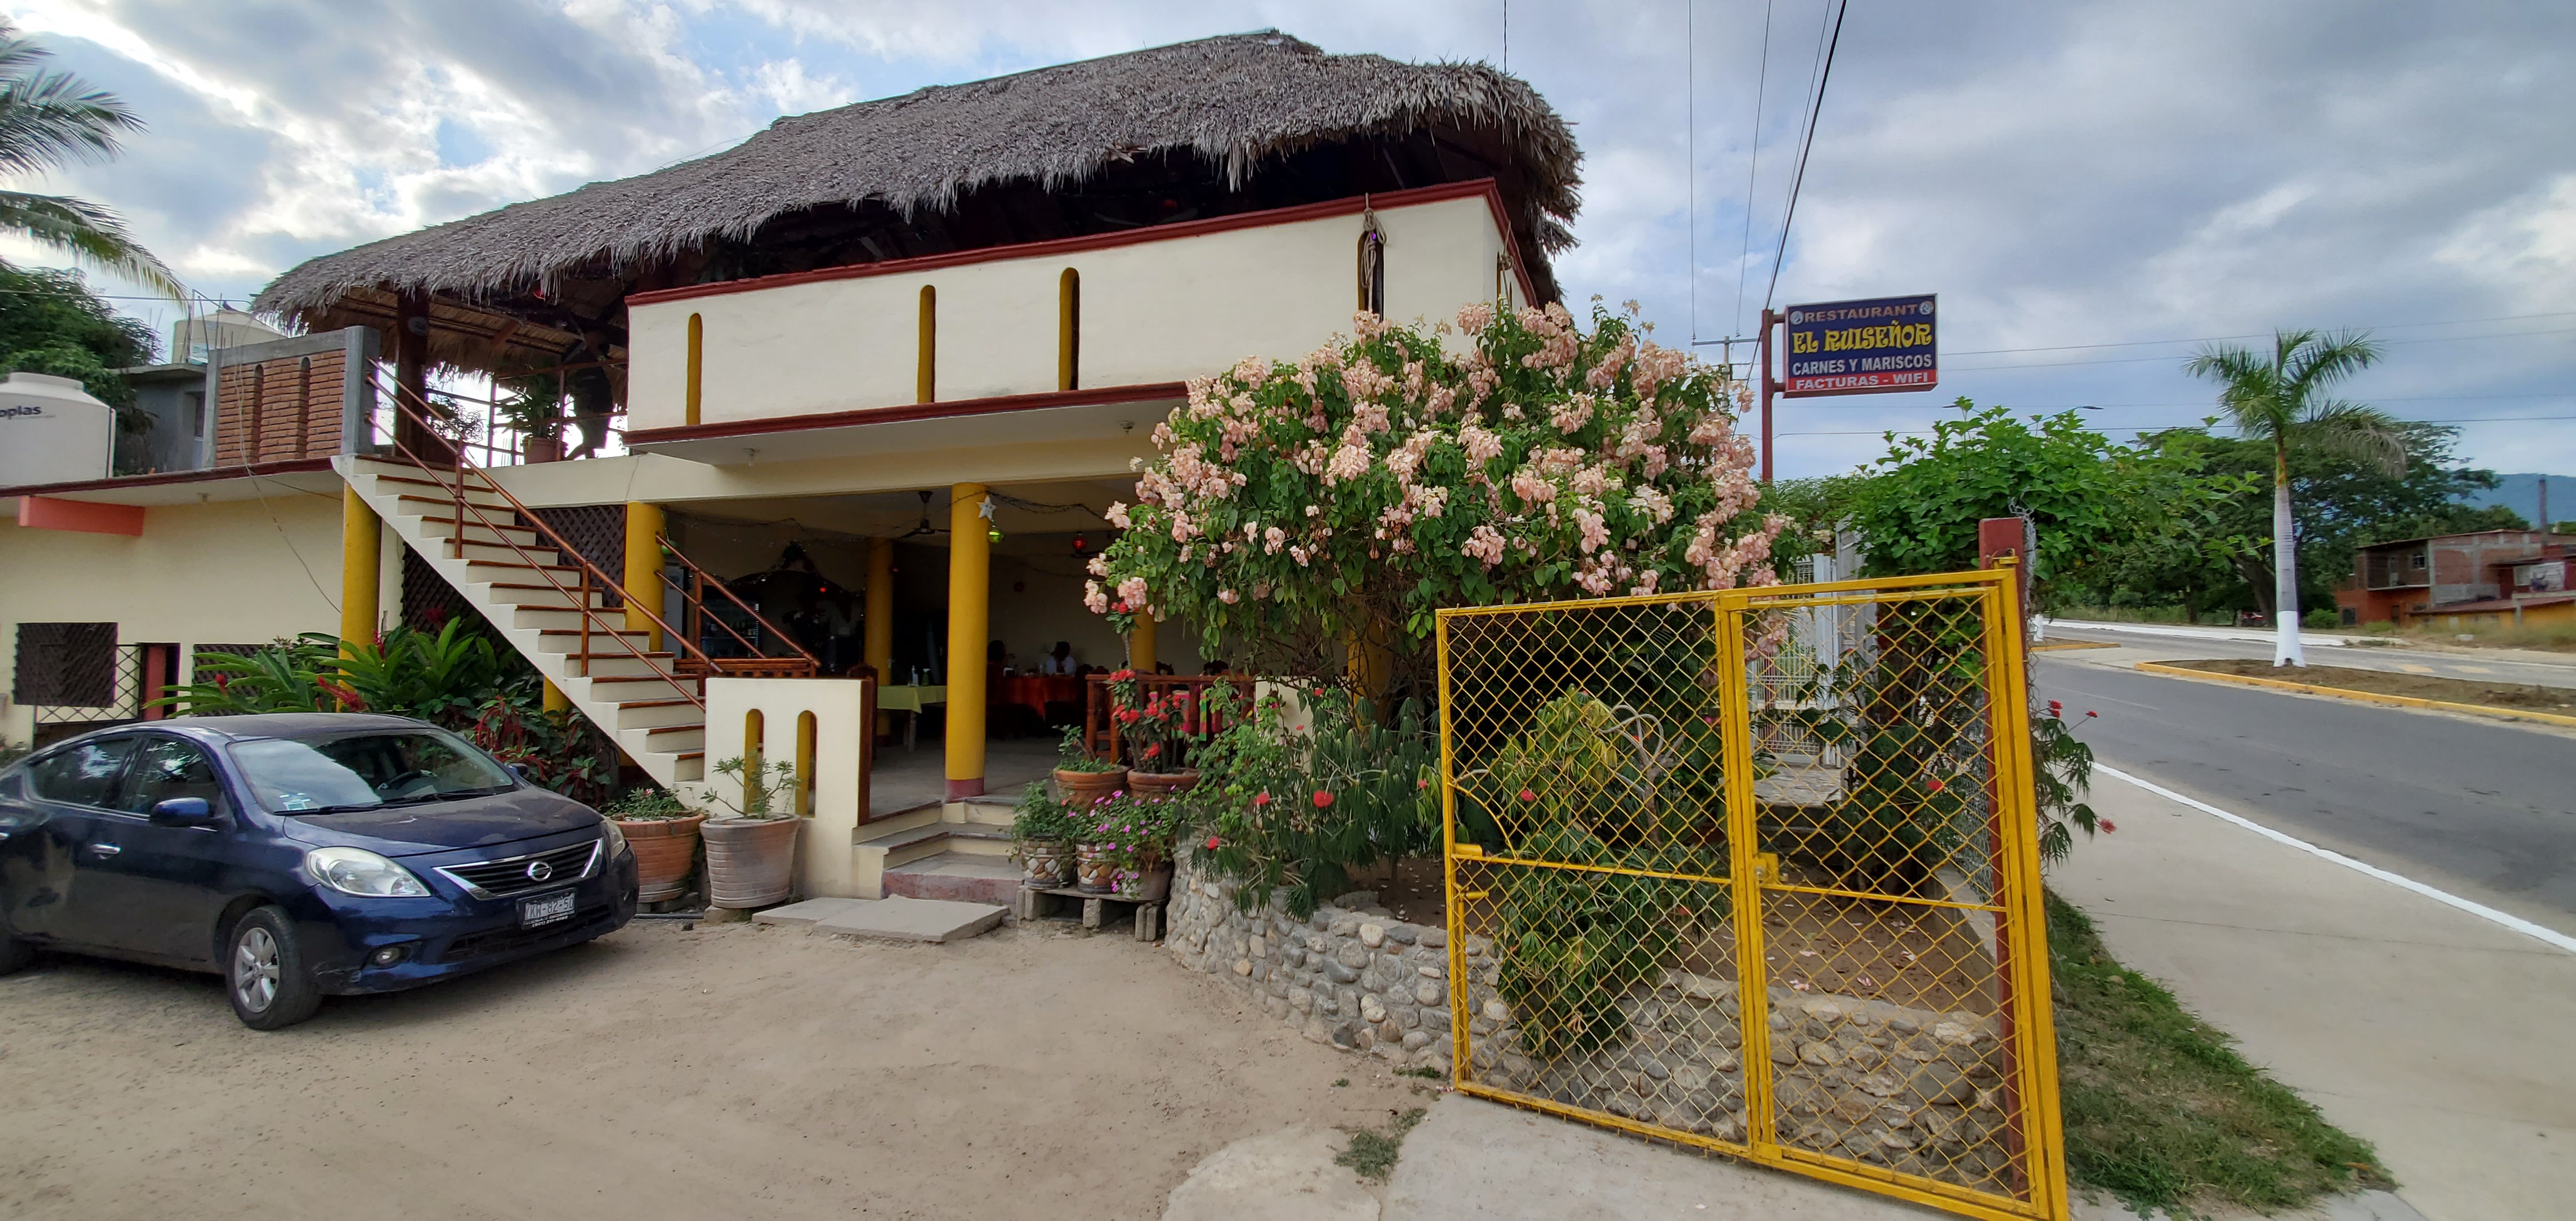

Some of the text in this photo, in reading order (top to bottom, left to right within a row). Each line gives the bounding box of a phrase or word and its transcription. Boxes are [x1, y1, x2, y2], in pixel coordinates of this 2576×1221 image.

[1805, 305, 1917, 323] RESTAURANT
[1792, 320, 1932, 353] EL RUISEÑOR
[1793, 354, 1932, 376] CARNES Y MARISCOS
[1796, 375, 1879, 390] FACTURAS
[1893, 372, 1928, 384] WIFI
[0, 405, 42, 420] oplas
